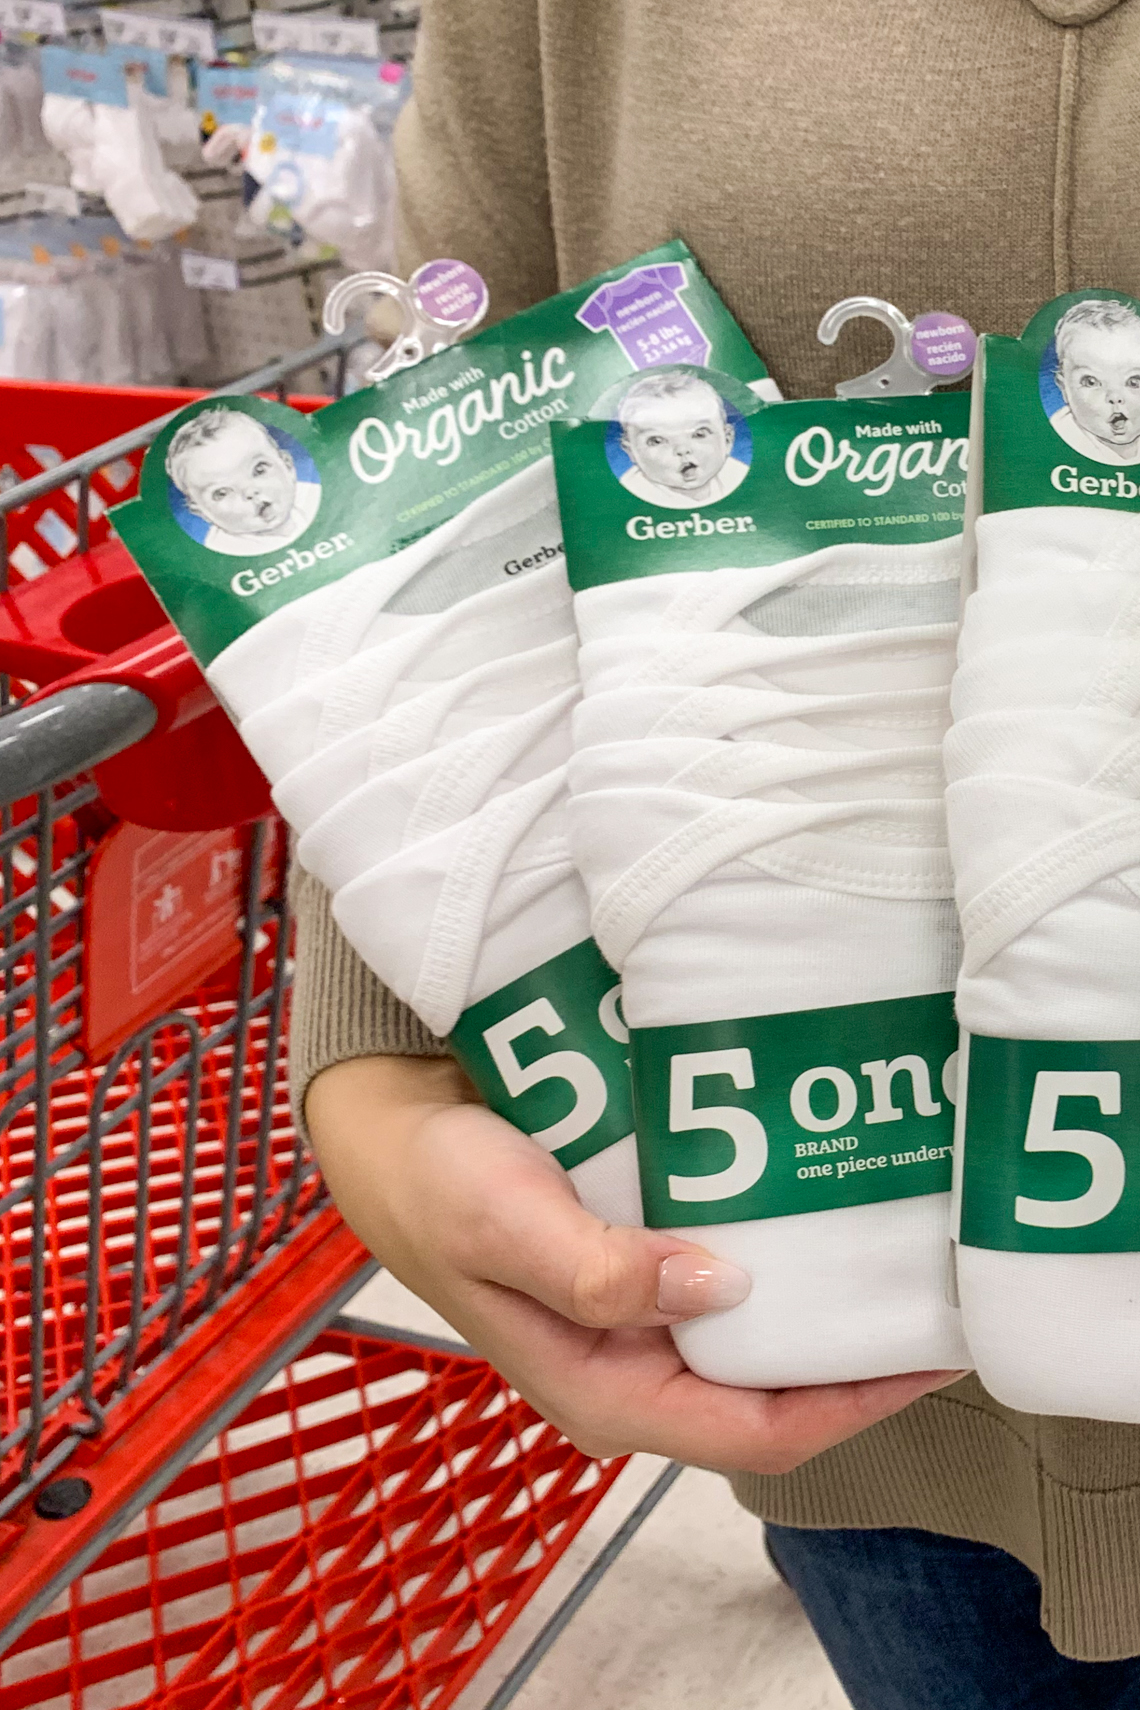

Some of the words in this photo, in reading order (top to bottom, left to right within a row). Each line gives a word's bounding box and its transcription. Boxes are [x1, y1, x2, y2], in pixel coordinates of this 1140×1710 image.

[418, 264, 466, 295] newborn
[441, 292, 478, 316] nacido
[616, 291, 663, 319] newborn
[915, 325, 966, 340] newborn
[927, 341, 962, 355] recién
[928, 351, 967, 366] nacido
[401, 386, 449, 415] Made
[448, 366, 486, 392] with
[349, 347, 575, 484] Organic
[498, 397, 570, 440] Cotton
[855, 422, 902, 438] Made
[905, 420, 942, 435] with
[805, 519, 856, 531] CERTIFIED
[857, 517, 873, 528] TO
[873, 513, 930, 527] STANDARD
[932, 511, 950, 522] 100
[482, 997, 608, 1153] 5
[668, 1047, 769, 1202] 5
[789, 1050, 959, 1133] on
[795, 1136, 859, 1158] BRAND
[1014, 1070, 1126, 1229] 5
[796, 1157, 833, 1180] one
[836, 1149, 888, 1179] piece
[890, 1144, 954, 1167] under
